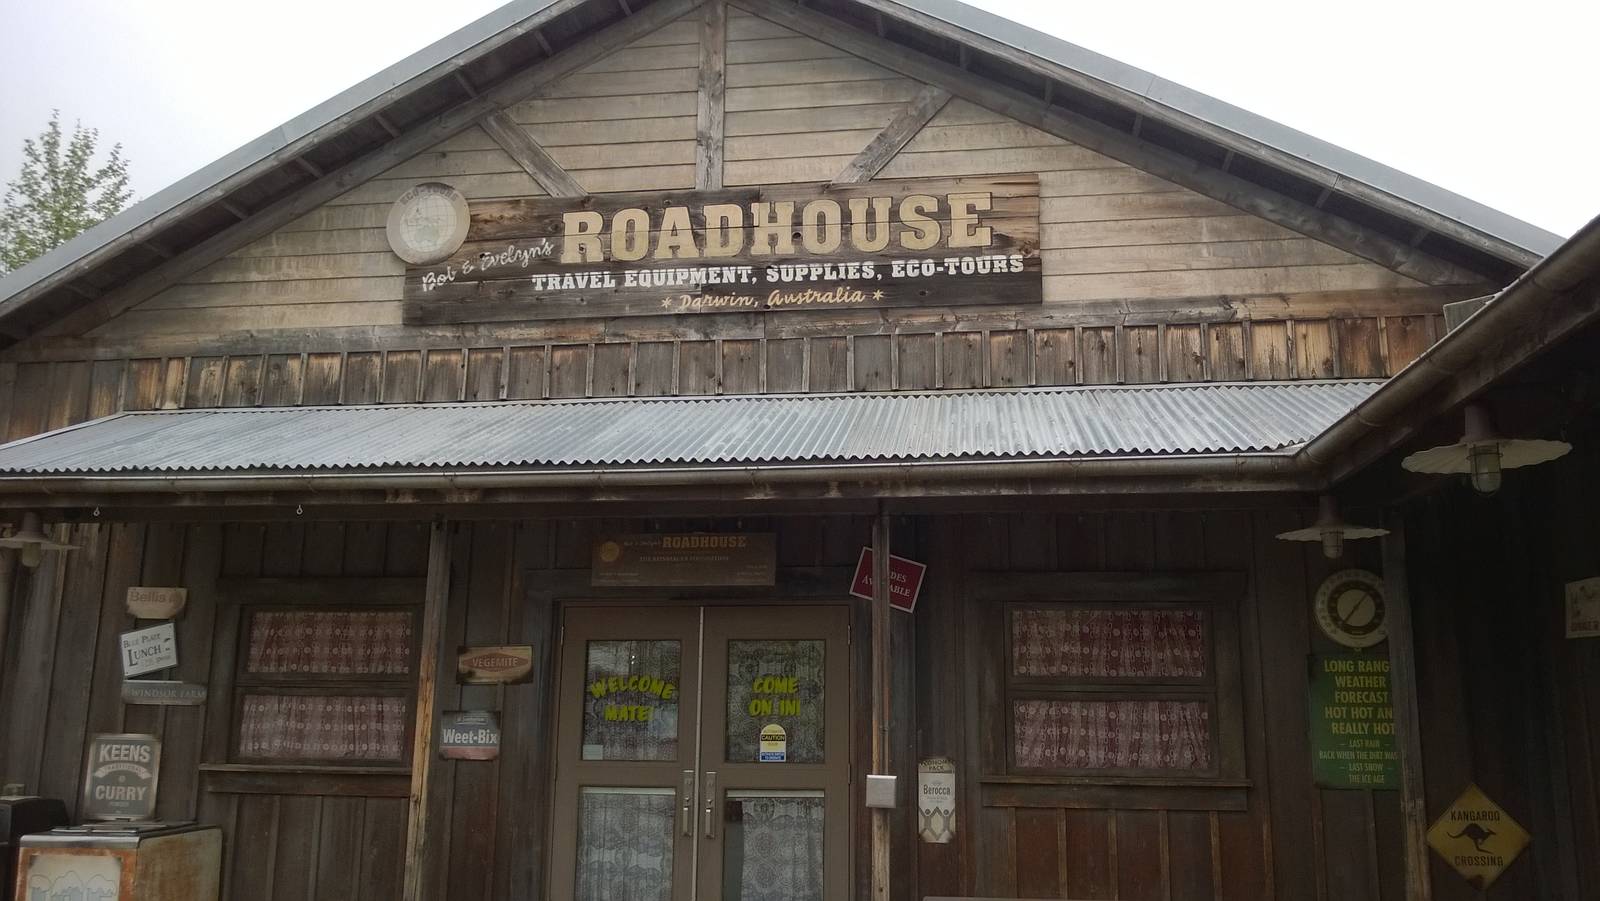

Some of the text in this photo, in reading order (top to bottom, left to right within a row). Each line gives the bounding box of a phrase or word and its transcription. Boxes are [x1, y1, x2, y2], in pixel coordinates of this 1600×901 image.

[560, 192, 993, 264] ROADHOUSE
[422, 238, 554, 292] Bob & Evelyn's
[531, 255, 1024, 291] TRAVEL EQUIPMENT, SUPPLIES, ECO-TOURS
[679, 287, 866, 310] Darwin, Australia
[662, 535, 746, 548] ROADHOUSE
[862, 575, 911, 597] AVABLE
[128, 644, 161, 667] LUNCH
[472, 657, 518, 668] VEGEMITE
[1324, 660, 1390, 673] LONG RANG
[590, 674, 674, 700] WELCOME
[753, 677, 799, 694] COME
[1335, 676, 1386, 687] WEATHER
[1335, 691, 1388, 703] FORECAST
[604, 704, 654, 722] MATE!
[749, 699, 800, 716] ON IN!
[1325, 706, 1393, 719] HOT HOT AN
[1331, 722, 1396, 735] REALLY HOT
[443, 728, 497, 744] Weet-Bix
[1349, 739, 1363, 748] LAST
[99, 743, 151, 762] KEENS
[1319, 751, 1335, 760] BACK
[1336, 751, 1355, 760] WHEN
[1356, 751, 1369, 760] THE
[1348, 763, 1384, 771] LAST SNOW
[1348, 774, 1385, 784] THE ICE AGE
[96, 785, 147, 801] CURRY
[923, 784, 951, 796] Berocca
[1450, 810, 1500, 821] KANGAROO
[1454, 856, 1504, 867] CROSSING
